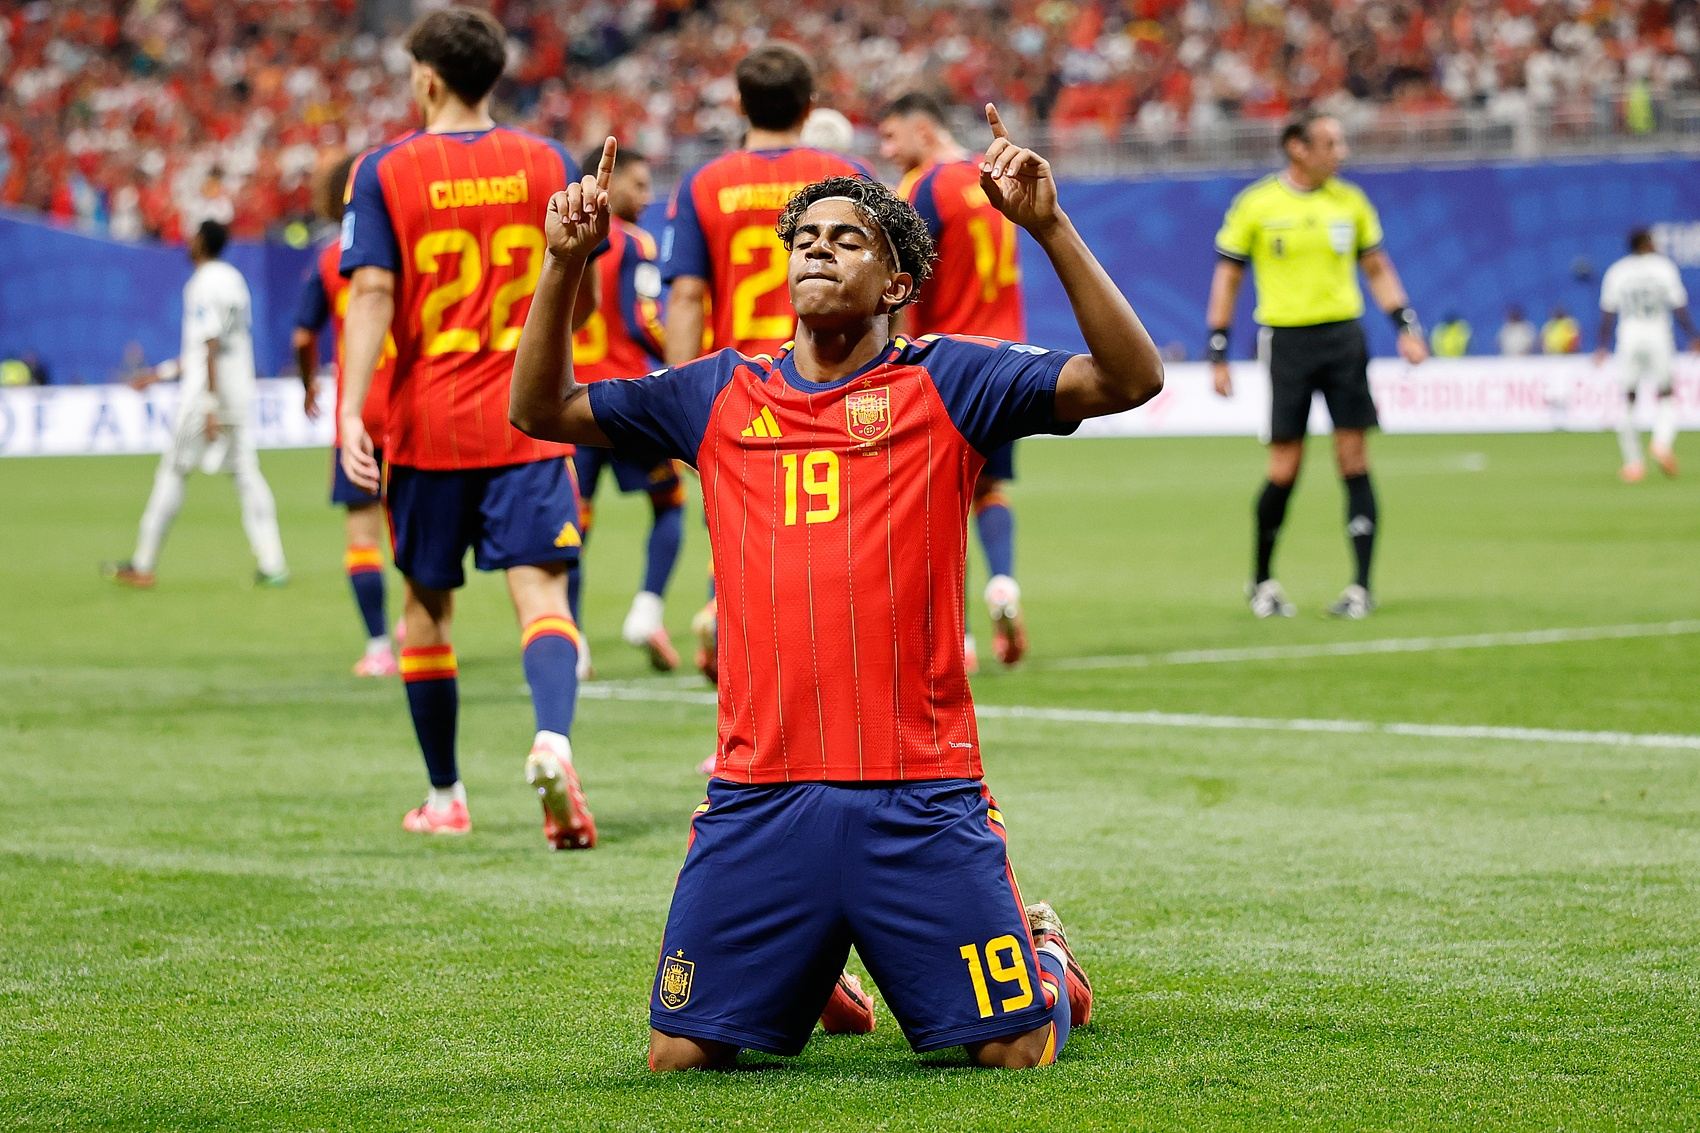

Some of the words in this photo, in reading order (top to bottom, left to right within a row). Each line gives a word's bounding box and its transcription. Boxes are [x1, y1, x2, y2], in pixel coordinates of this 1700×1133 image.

[414, 223, 546, 356] 22
[782, 450, 840, 526] 19
[960, 934, 1034, 1019] 19
